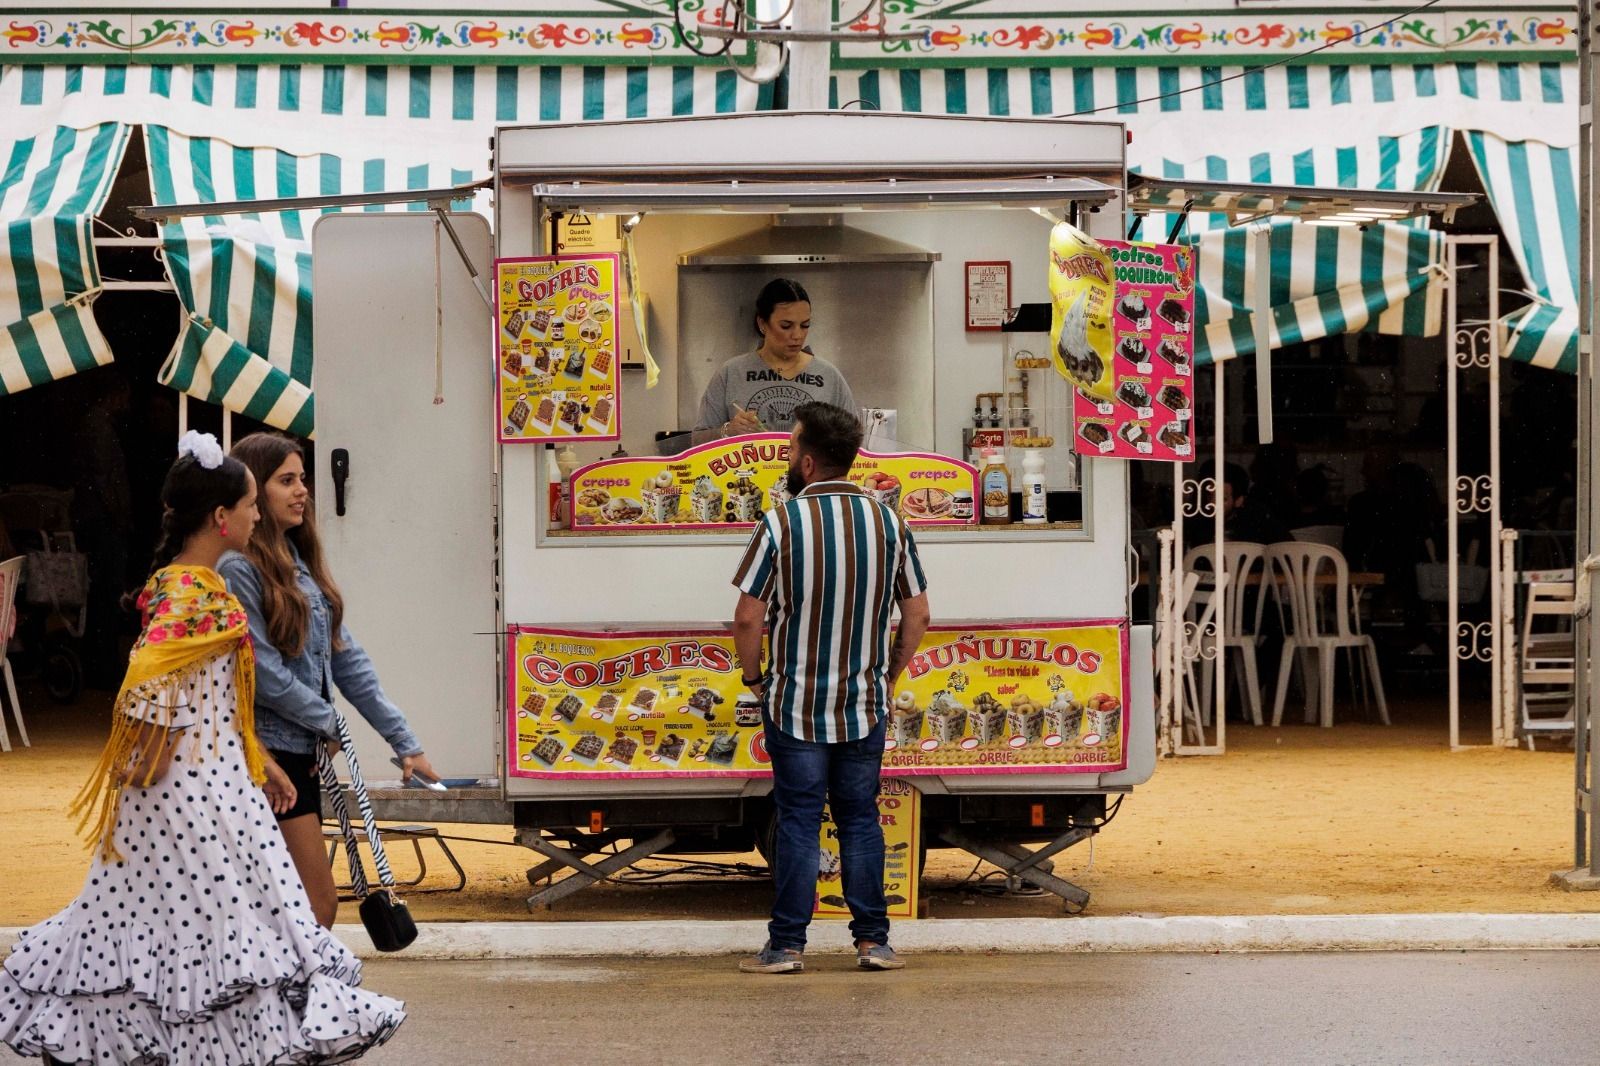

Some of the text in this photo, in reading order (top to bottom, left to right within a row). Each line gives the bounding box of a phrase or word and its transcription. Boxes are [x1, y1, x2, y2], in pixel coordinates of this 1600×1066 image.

[1110, 246, 1163, 267] Gofres
[518, 263, 600, 302] GOFRES
[746, 369, 824, 388] RAMNES
[979, 434, 1002, 442] Corte
[708, 442, 790, 477] BUÑUE
[582, 478, 631, 489] crepes
[909, 470, 958, 481] crepes
[523, 640, 734, 689] GOFRES
[907, 634, 1102, 679] BUÑUELOS
[891, 754, 925, 767] ORBIE
[979, 752, 1013, 764] ORBIE
[1073, 752, 1108, 764] ORBIE
